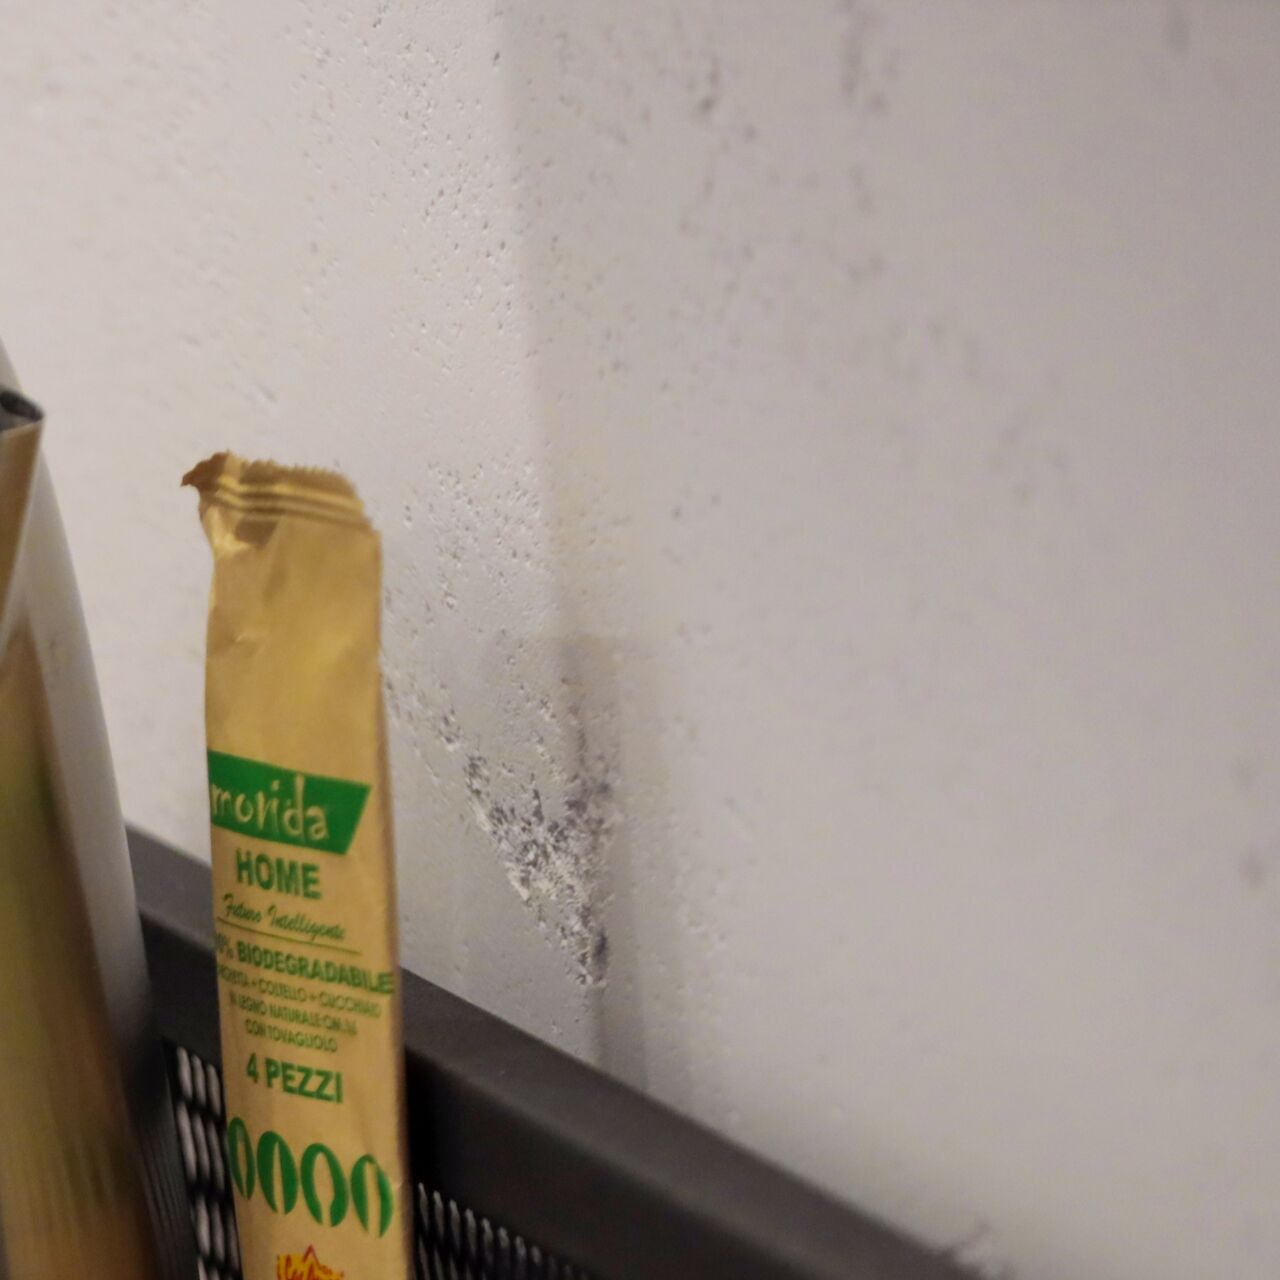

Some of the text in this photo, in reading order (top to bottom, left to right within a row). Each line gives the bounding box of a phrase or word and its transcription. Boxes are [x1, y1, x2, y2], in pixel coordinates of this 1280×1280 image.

[235, 848, 322, 901] HOME
[236, 940, 393, 994] BIODEGRADABILE
[246, 1053, 344, 1105] 4 PEZZI
